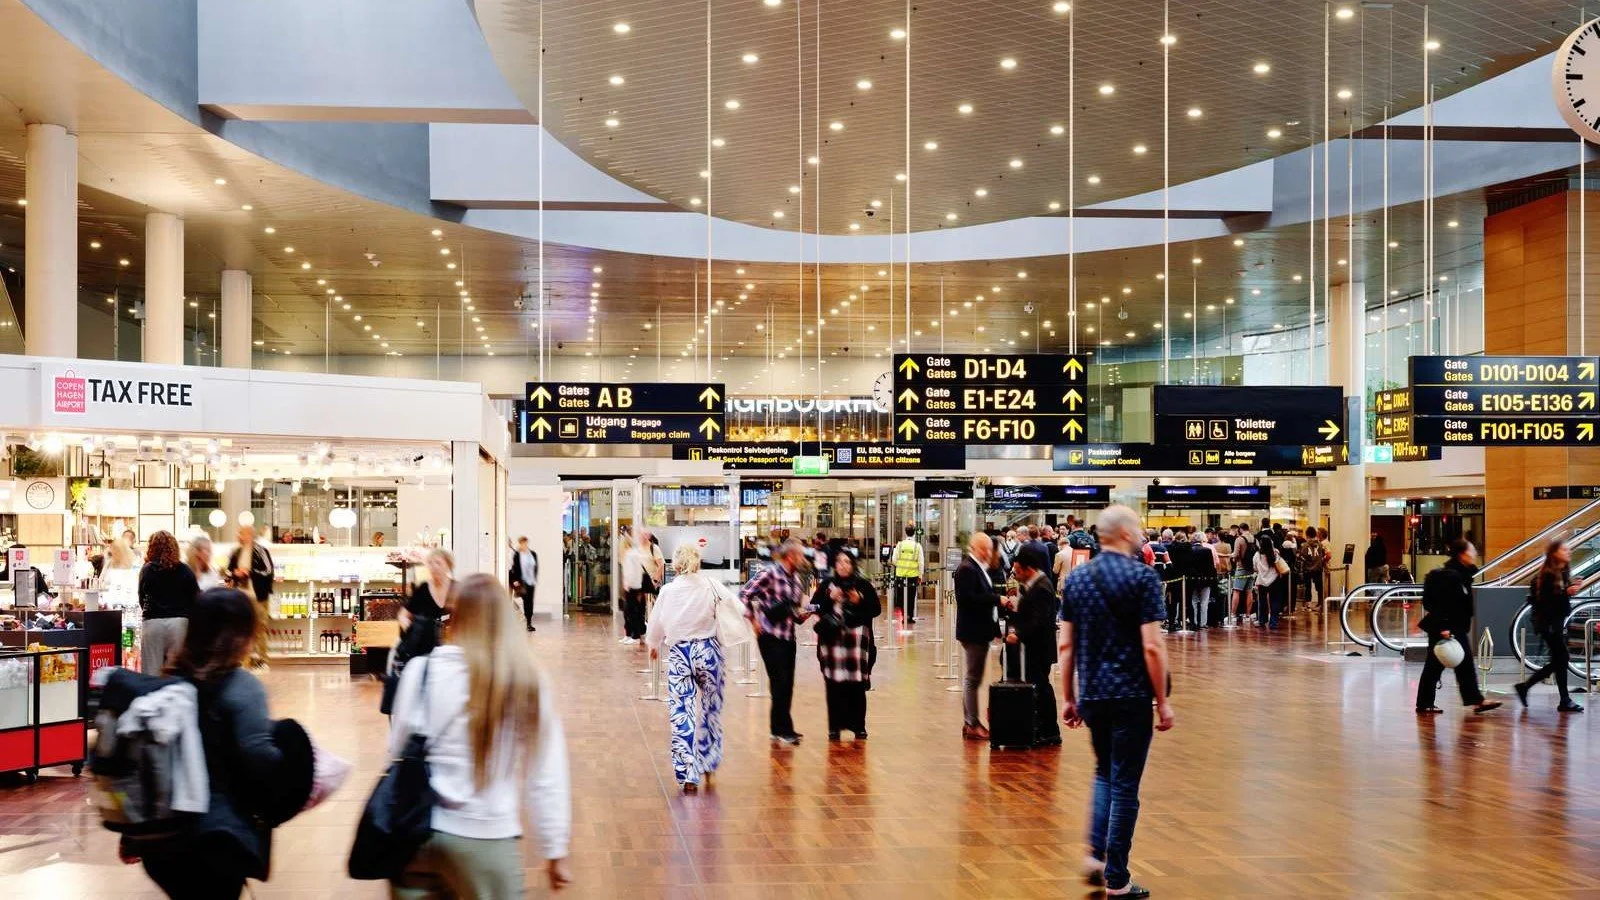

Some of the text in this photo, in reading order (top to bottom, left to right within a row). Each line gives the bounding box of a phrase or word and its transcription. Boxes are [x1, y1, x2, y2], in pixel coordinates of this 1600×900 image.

[926, 356, 950, 366] Gate
[1444, 360, 1468, 370] Gate
[964, 358, 1026, 379] D1-D4
[1480, 364, 1569, 382] D101-D104
[926, 369, 956, 379] Gates
[1444, 372, 1474, 382] Gates
[56, 382, 84, 390] COPEN
[558, 386, 590, 396] Gates
[88, 378, 192, 406] TAX FREE
[926, 388, 950, 398] Gate
[1444, 390, 1468, 400] Gate
[597, 387, 633, 408] A B
[964, 389, 1036, 409] E1-E24
[558, 398, 590, 408] Gates
[926, 400, 956, 410] Gates
[1444, 402, 1474, 412] Gates
[1481, 394, 1574, 412] E105-E136
[586, 416, 627, 428] Udgang
[631, 419, 662, 427] Bagage
[926, 418, 950, 428] Gate
[1235, 418, 1276, 429] Toiletter
[1444, 420, 1468, 429] Gate
[586, 428, 606, 438] Exit
[964, 419, 1035, 440] F6-F10
[1480, 423, 1565, 440] F101-F105
[631, 431, 666, 440] Baggage
[926, 430, 956, 440] Gates
[1235, 430, 1268, 441] Toilets
[1444, 432, 1474, 441] Gates
[744, 447, 788, 455] Selvbetjening
[896, 447, 921, 455] borgere
[1458, 502, 1482, 510] Border
[92, 658, 110, 668] LOW
